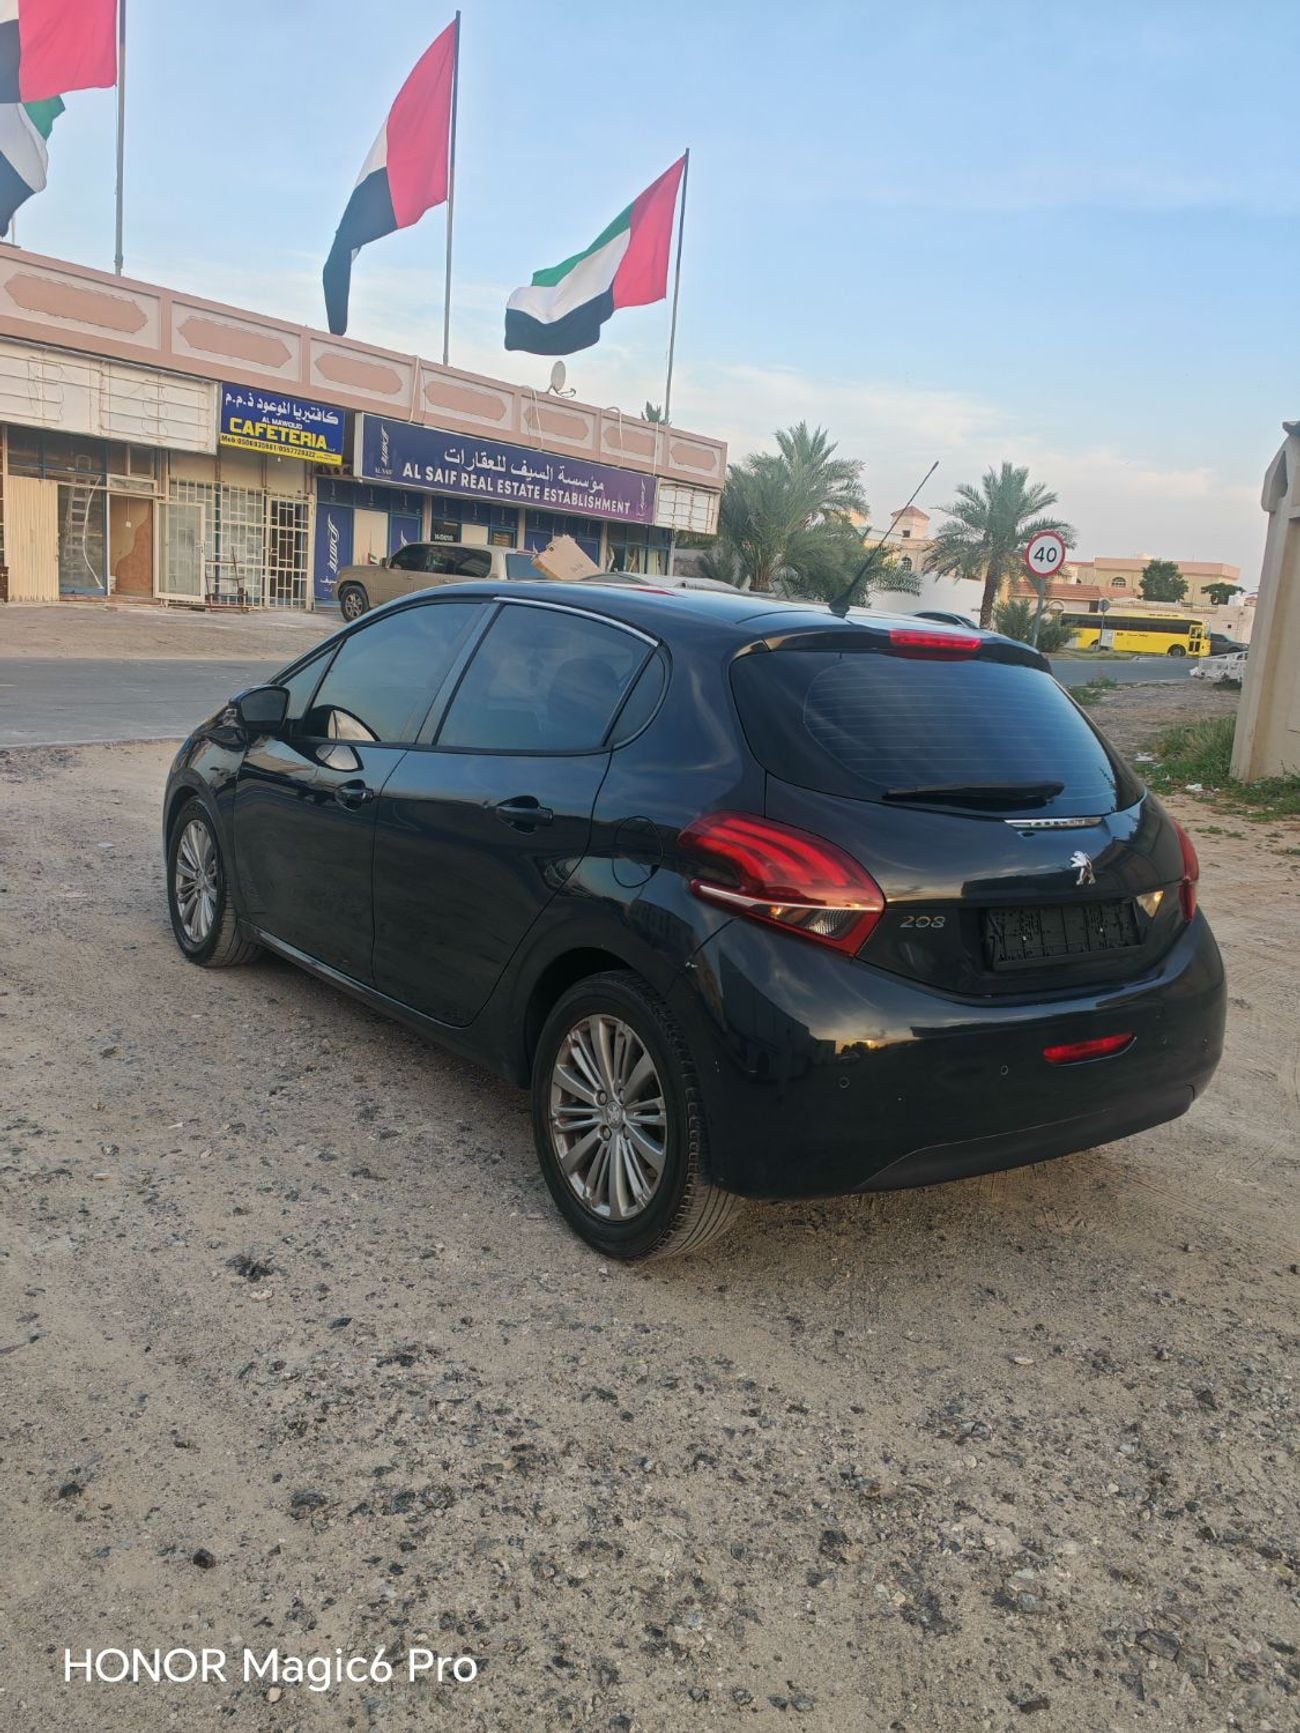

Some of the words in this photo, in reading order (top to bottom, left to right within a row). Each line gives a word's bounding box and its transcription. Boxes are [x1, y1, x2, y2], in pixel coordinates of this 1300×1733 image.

[256, 398, 290, 416] الموعود
[293, 404, 339, 425] كافتيريا
[229, 417, 327, 450] CAFETERIA
[444, 449, 506, 472] للعقارات
[511, 460, 553, 482] السيف
[403, 462, 421, 479] AL
[425, 466, 457, 484] SAIF
[461, 473, 493, 491] REAL
[497, 479, 540, 499] ESTATE
[543, 487, 630, 514] ESTABLISHMENT
[558, 465, 605, 493] مؤسسة
[1033, 547, 1057, 563] 40
[900, 915, 946, 928] 208
